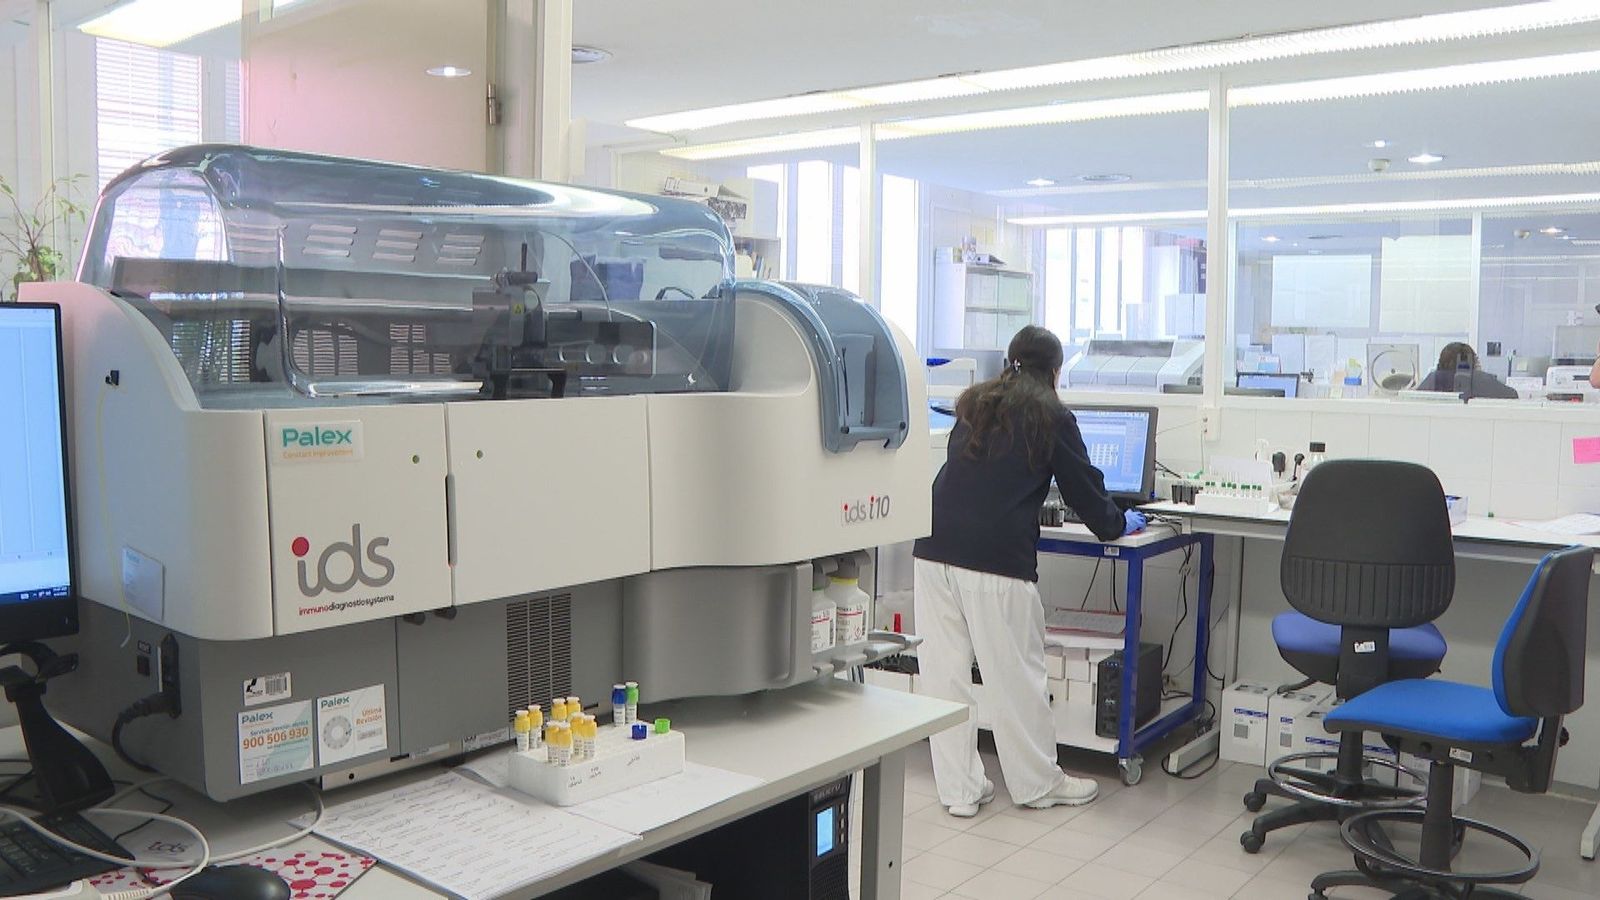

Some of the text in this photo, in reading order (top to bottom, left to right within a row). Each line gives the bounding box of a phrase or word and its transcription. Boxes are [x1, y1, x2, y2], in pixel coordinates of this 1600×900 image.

[282, 426, 352, 447] Palex
[844, 495, 890, 523] ids i10
[292, 523, 395, 597] ids
[321, 697, 350, 709] Palex
[242, 711, 273, 724] Palex
[243, 737, 264, 750] 900
[267, 732, 287, 745] 506
[289, 727, 309, 740] 930
